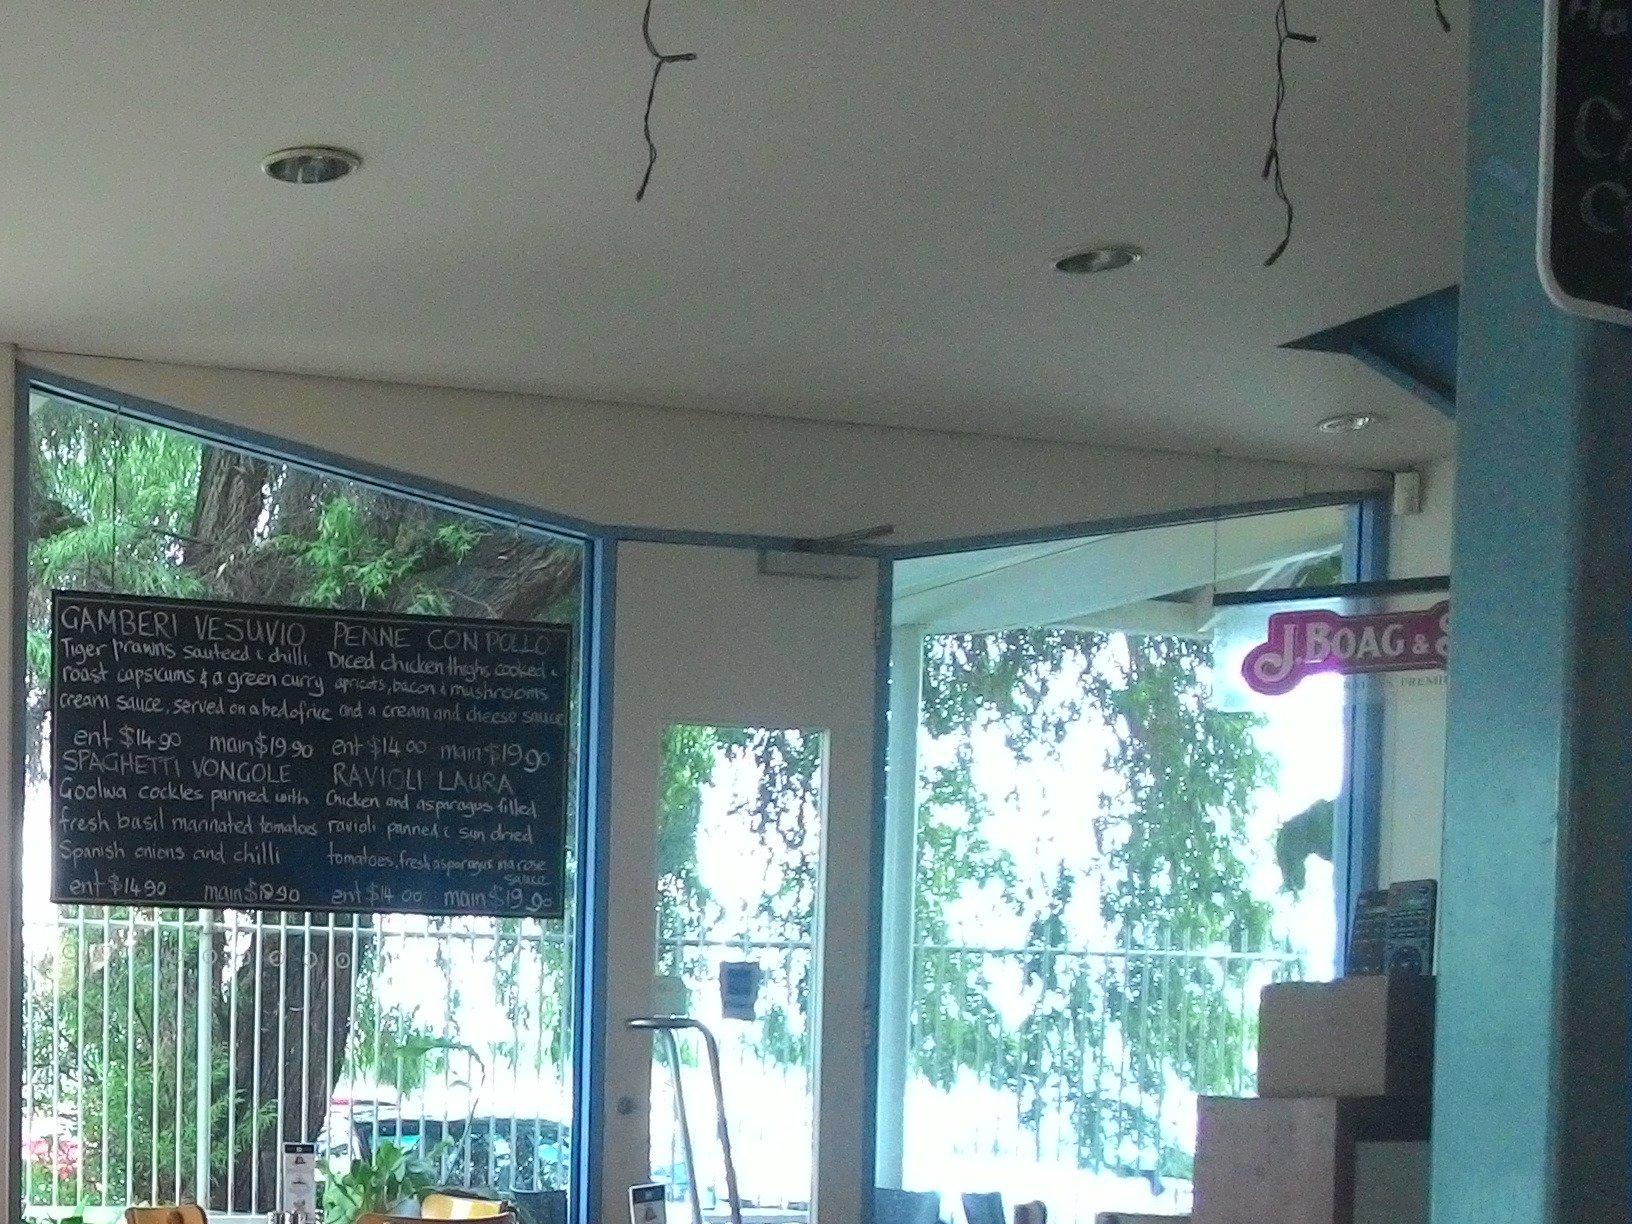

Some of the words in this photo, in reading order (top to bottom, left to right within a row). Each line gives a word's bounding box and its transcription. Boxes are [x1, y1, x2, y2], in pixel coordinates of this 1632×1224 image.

[61, 604, 178, 639] GAMBERI
[195, 614, 307, 646] VESUVIO
[333, 620, 412, 650] PENNE
[427, 629, 479, 651] CON
[486, 631, 551, 655] POLLO
[61, 637, 109, 665] Tiger
[112, 638, 177, 662] prawns
[1305, 620, 1406, 662] BOAG
[326, 650, 376, 670] Diced
[380, 653, 445, 675] chicken
[62, 662, 109, 684] roast
[117, 666, 196, 689] capsicums
[212, 670, 224, 687] a
[227, 671, 278, 694] green
[281, 672, 325, 698] curry
[392, 677, 436, 695] bacon
[59, 691, 109, 710] cream
[173, 697, 225, 716] served
[229, 703, 246, 716] on
[339, 701, 363, 720] and
[382, 705, 431, 722] cream
[434, 703, 462, 723] and
[73, 719, 114, 750] ent
[209, 733, 253, 755] main
[331, 733, 364, 757] ent
[61, 749, 181, 778] SPAGHETTI
[192, 756, 293, 784] VONGOLE
[439, 743, 483, 762] main
[332, 762, 423, 791] RAVIOLI
[438, 770, 515, 796] LAURA
[59, 776, 128, 801] Goolwa
[137, 781, 205, 801] cockles
[211, 786, 268, 812] panned
[274, 787, 311, 806] with
[326, 789, 381, 809] Chicken
[385, 793, 410, 811] and
[416, 799, 494, 819] asparagus
[58, 804, 111, 835] fresh
[117, 806, 165, 833] basil
[327, 815, 378, 835] ravioli
[386, 820, 440, 842] panned
[459, 828, 487, 843] sun
[490, 824, 534, 846] dried
[58, 839, 126, 868] Spanish
[134, 844, 187, 862] onions
[193, 841, 227, 865] and
[232, 841, 281, 866] chilli
[69, 868, 107, 898] ent
[204, 884, 244, 903] main
[331, 881, 363, 905] ent
[444, 890, 487, 908] main
